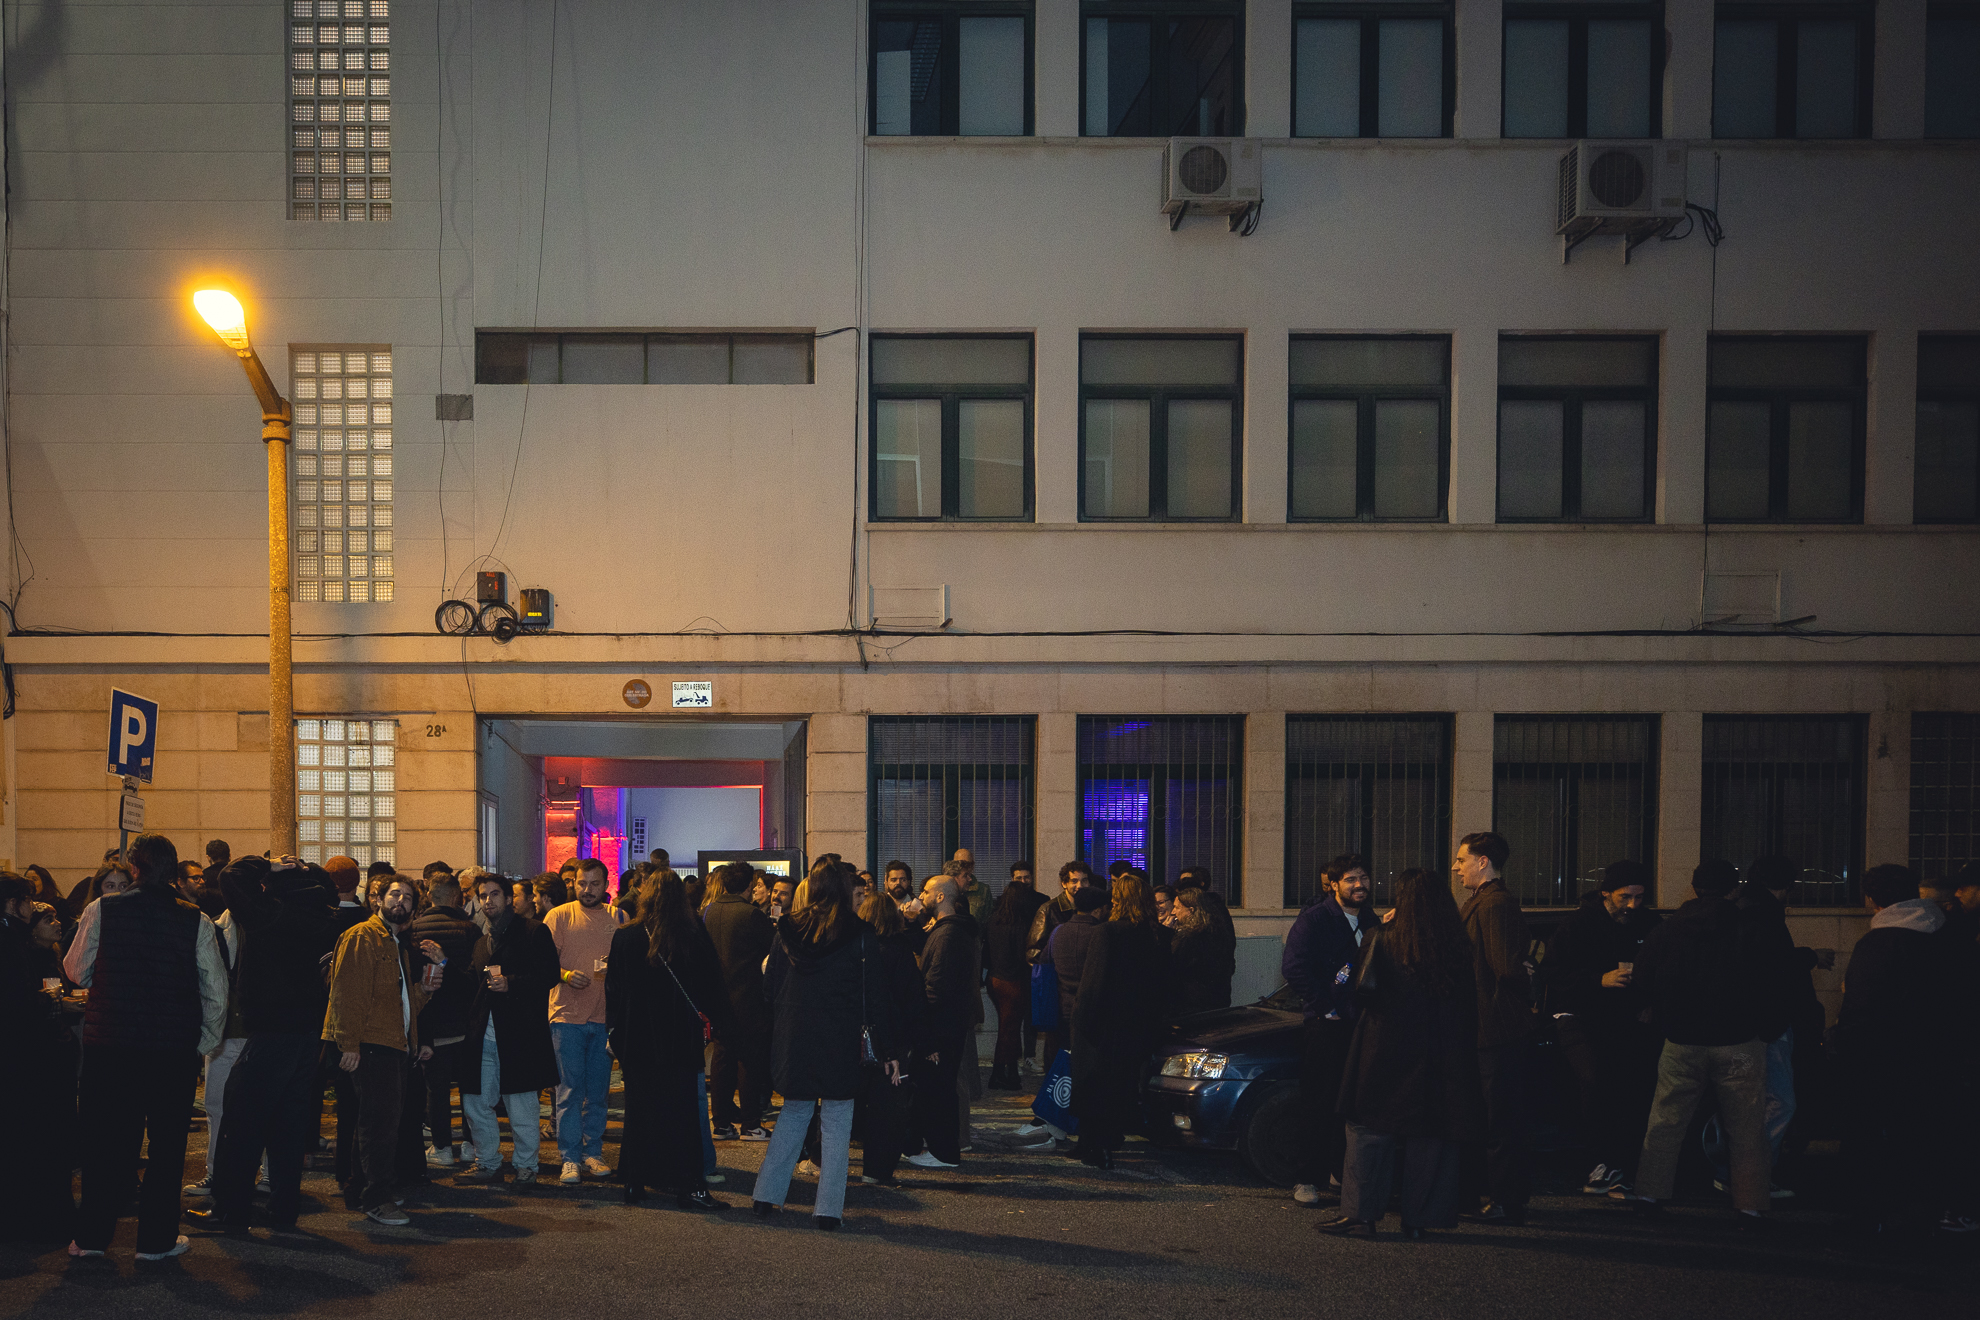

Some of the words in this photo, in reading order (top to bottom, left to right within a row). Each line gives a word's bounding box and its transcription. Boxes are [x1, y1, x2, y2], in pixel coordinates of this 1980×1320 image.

[674, 683, 689, 691] SUJEITO
[693, 683, 710, 691] REBOQUE
[119, 703, 147, 764] P
